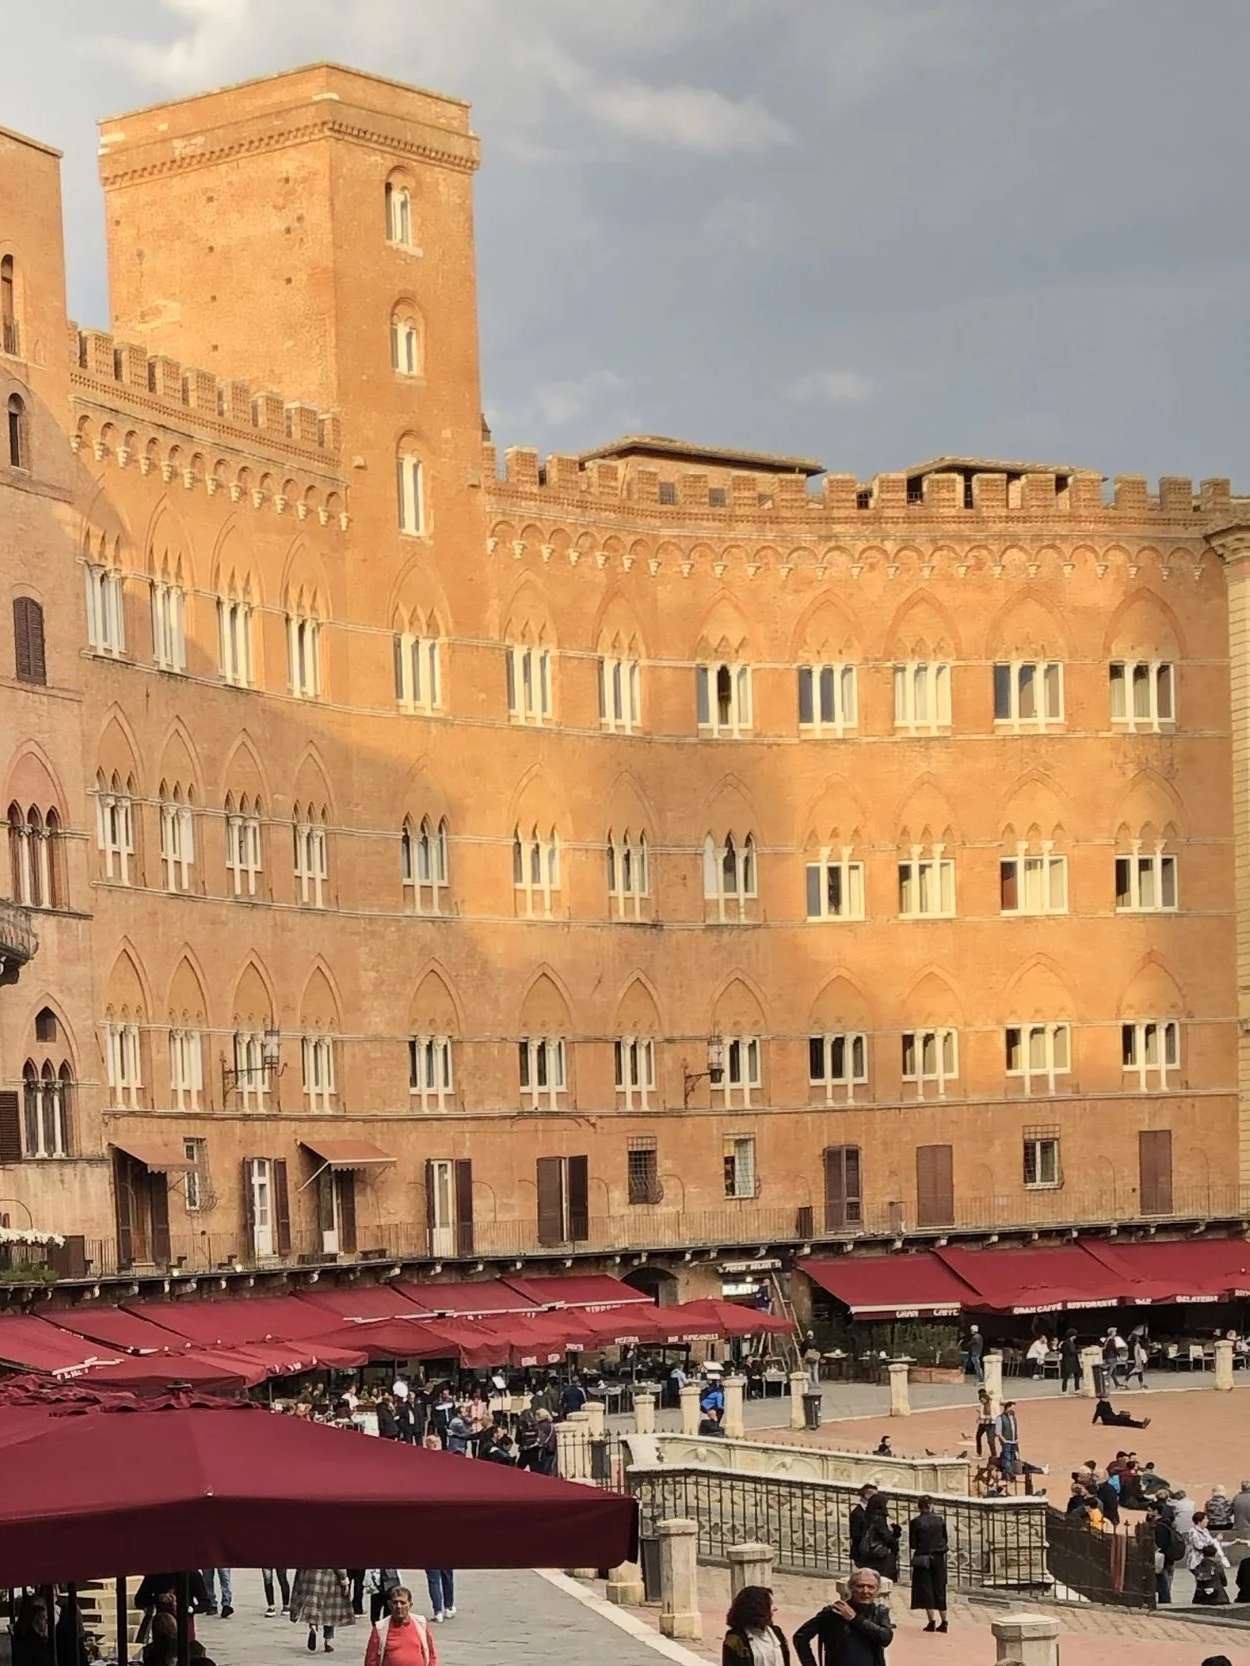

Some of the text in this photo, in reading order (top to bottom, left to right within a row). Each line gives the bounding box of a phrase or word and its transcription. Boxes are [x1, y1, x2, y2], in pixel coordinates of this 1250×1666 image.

[1066, 1298, 1118, 1309] RISTORANTE
[1175, 1295, 1219, 1304] GELATERIA
[1012, 1306, 1037, 1315] GRAN
